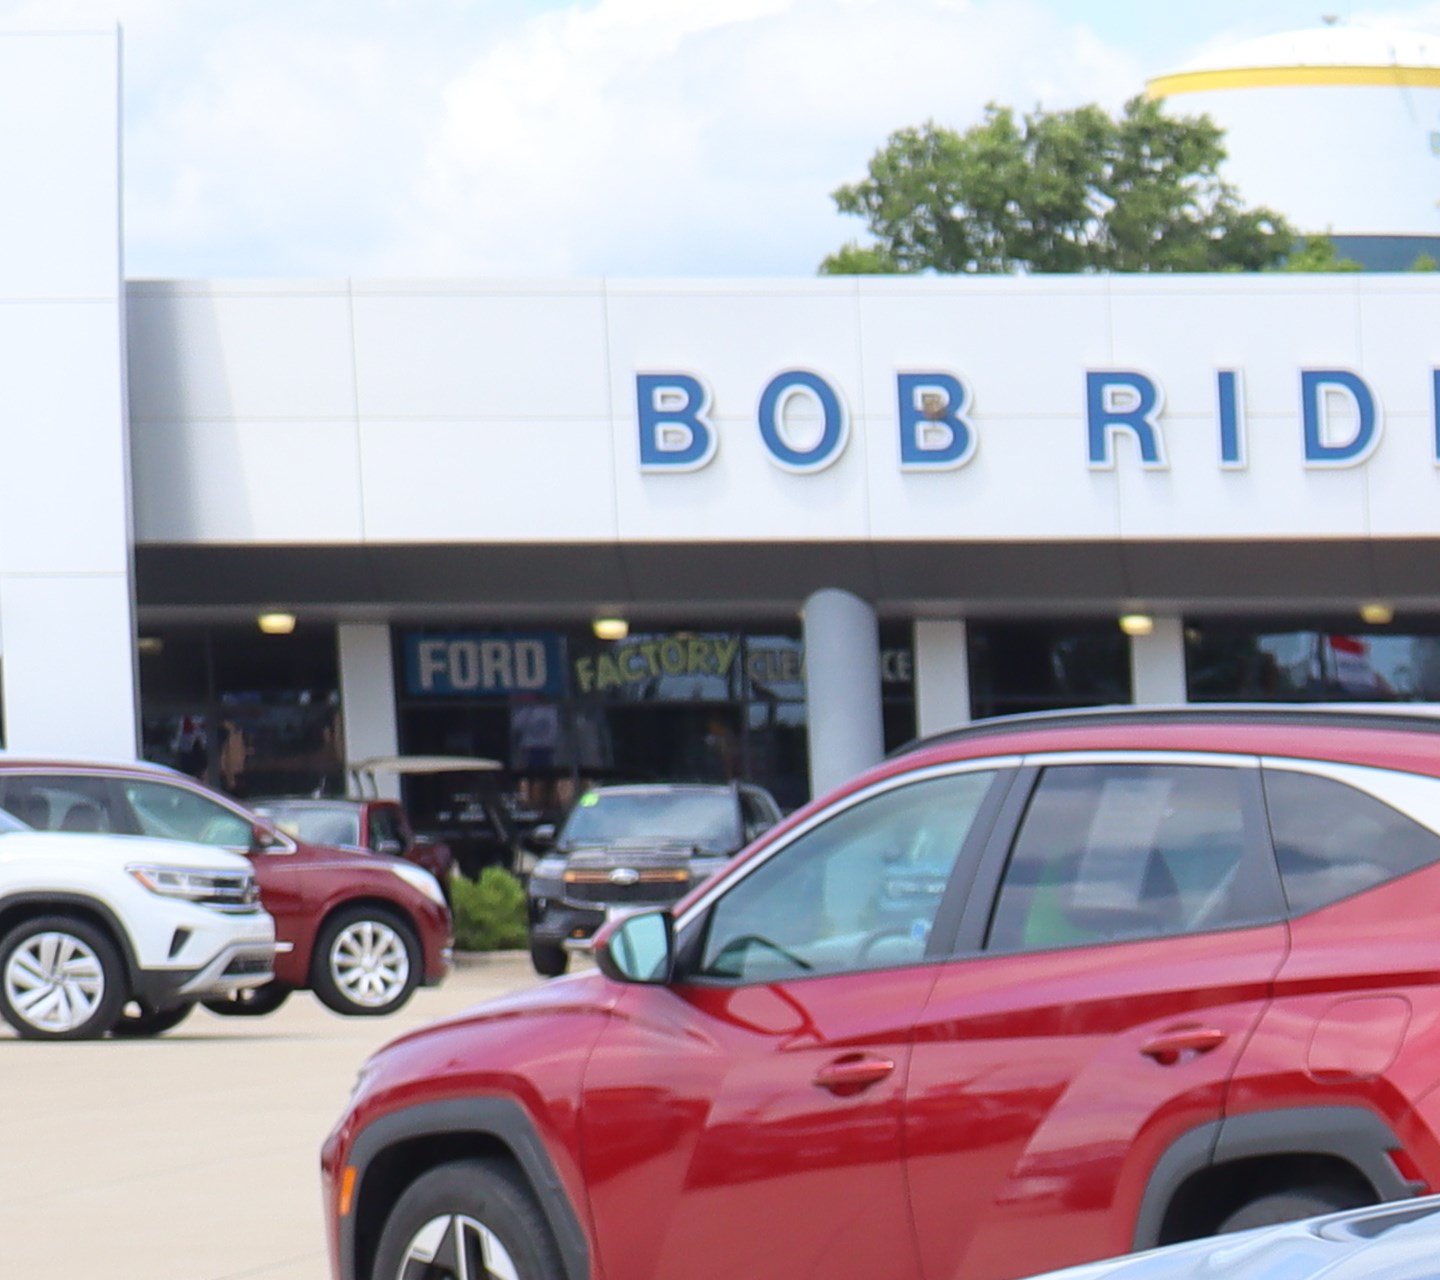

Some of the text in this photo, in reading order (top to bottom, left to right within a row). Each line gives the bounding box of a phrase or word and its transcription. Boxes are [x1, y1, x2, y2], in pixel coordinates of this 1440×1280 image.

[634, 368, 976, 470] BOB
[417, 638, 548, 691] FORD
[576, 636, 913, 694] FACTORY CLECE
